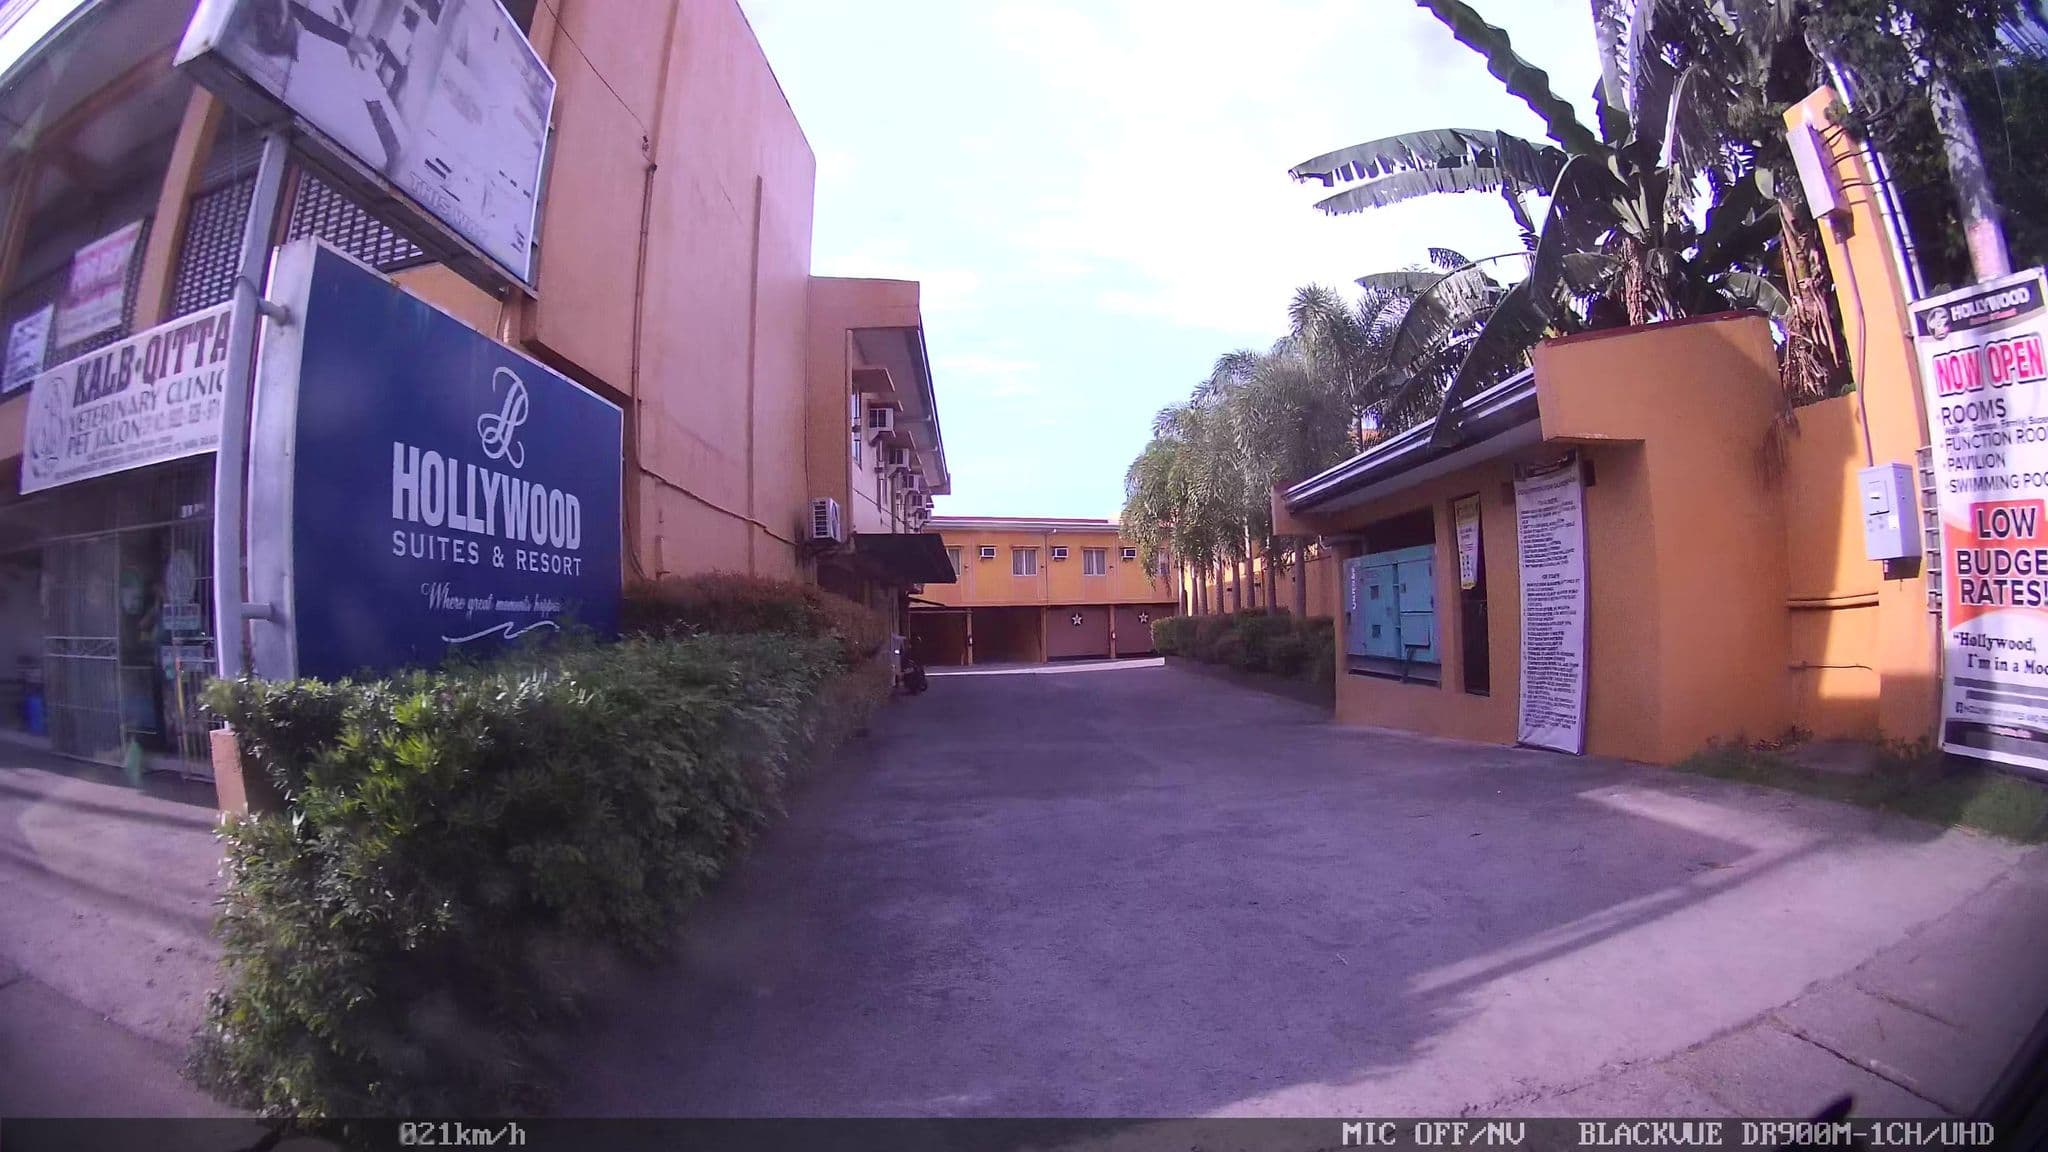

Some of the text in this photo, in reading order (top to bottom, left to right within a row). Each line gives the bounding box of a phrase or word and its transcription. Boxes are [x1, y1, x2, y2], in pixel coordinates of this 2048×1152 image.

[1950, 287, 2030, 321] HOLLYWOOD
[1935, 338, 2044, 393] NOW OPEN
[1941, 398, 2007, 426] ROOMS
[1945, 426, 2048, 452] FUNCTION ROO
[1948, 452, 2006, 471] PAVILION
[392, 441, 581, 550] HOLLYWOOD
[1950, 474, 2019, 493] SWIMMING
[1977, 507, 2036, 538] LOW
[392, 530, 581, 576] SUITES & RESORT
[1956, 549, 2048, 576] BUDGE
[421, 582, 465, 611] Where
[1961, 579, 2048, 607] RATES!
[1995, 656, 2009, 672] in
[2012, 661, 2020, 672] a
